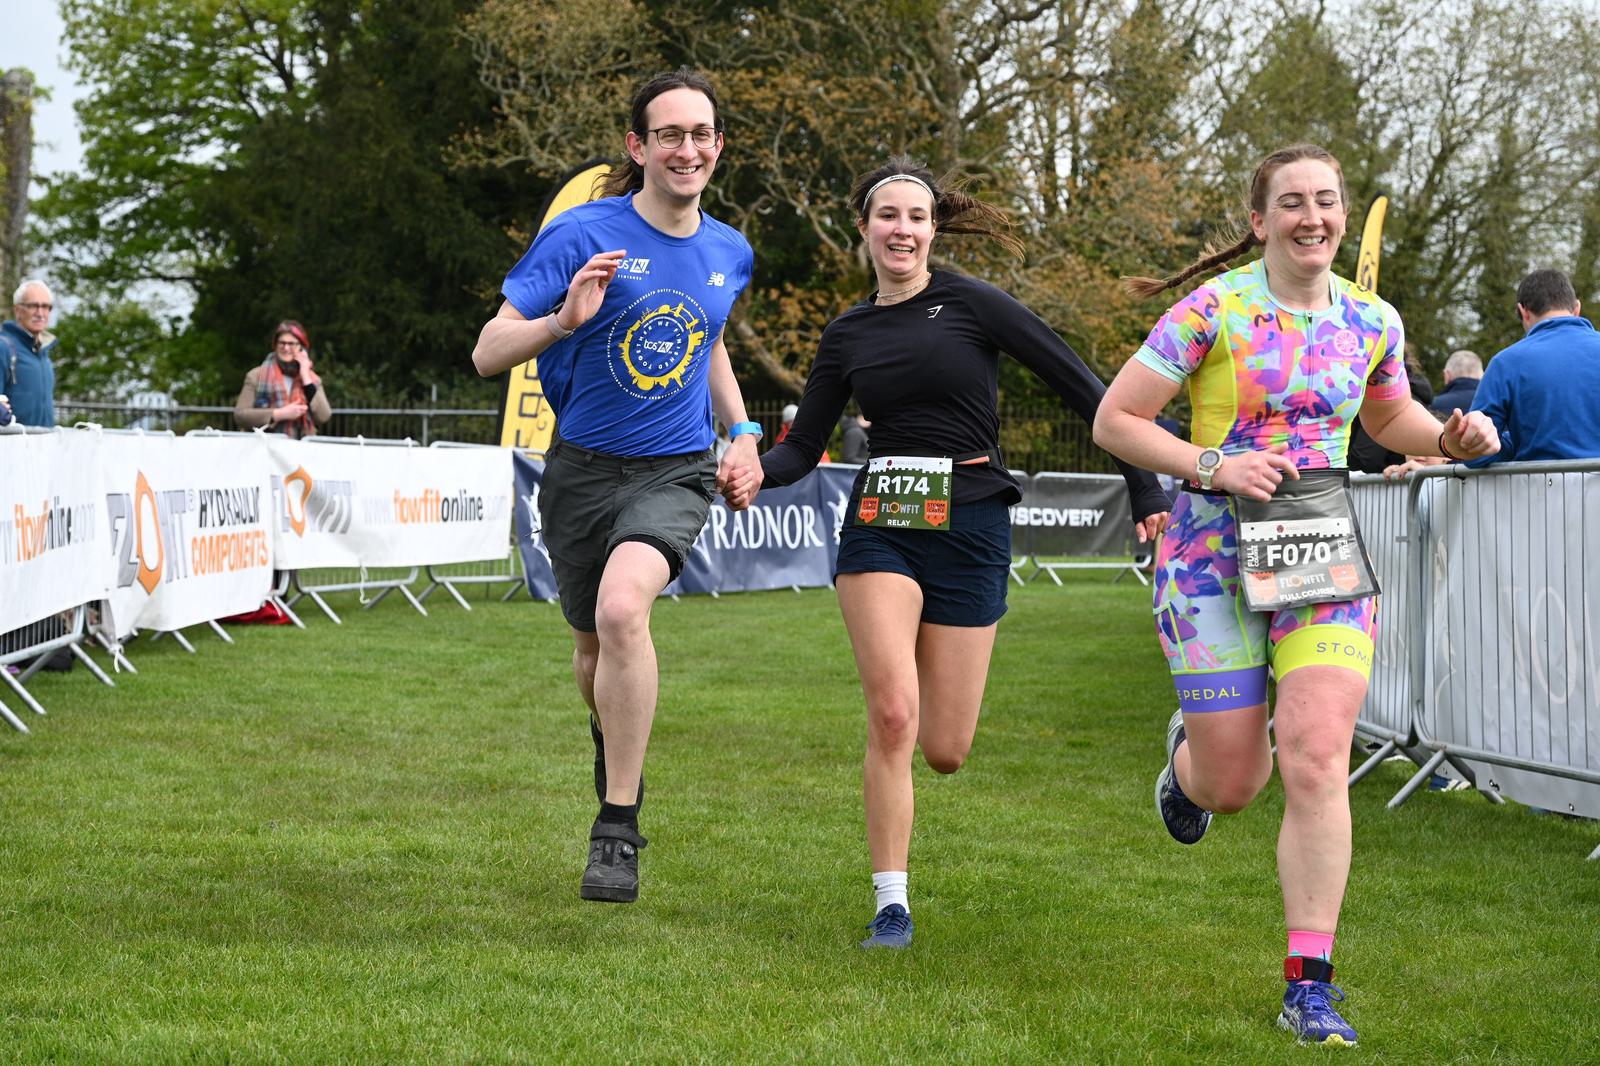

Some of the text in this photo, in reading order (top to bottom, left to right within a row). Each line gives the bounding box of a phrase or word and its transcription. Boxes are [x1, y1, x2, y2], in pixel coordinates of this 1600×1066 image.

[876, 475, 931, 496] R174
[881, 501, 920, 515] FLOWFIT
[711, 503, 824, 552] RADNOR
[887, 518, 911, 527] RELAY
[1266, 541, 1332, 568] F070
[1280, 586, 1337, 602] FULL COURSE
